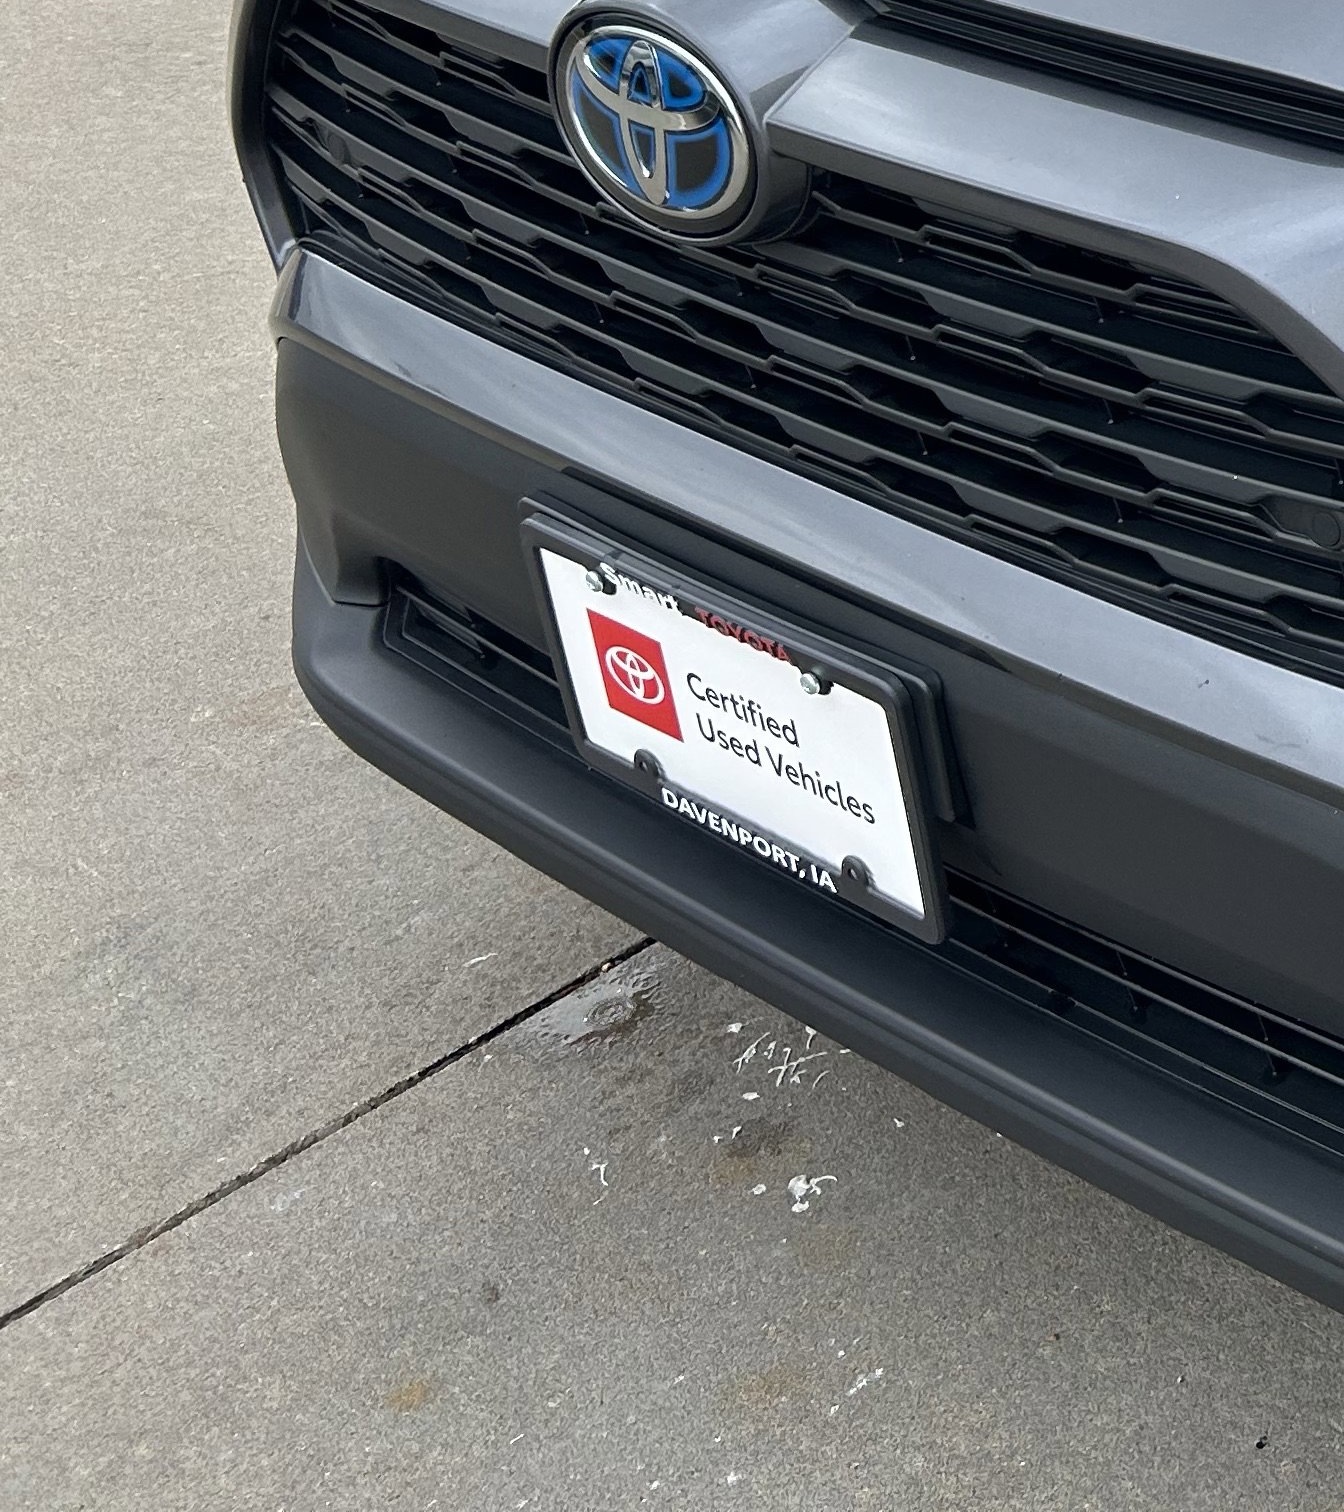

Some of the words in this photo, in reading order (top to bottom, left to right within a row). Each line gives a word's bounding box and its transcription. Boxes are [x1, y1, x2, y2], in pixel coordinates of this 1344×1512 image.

[600, 562, 680, 610] Smart
[694, 606, 791, 662] TOYOTA
[686, 672, 800, 748] Certified
[695, 712, 762, 768] Used
[765, 745, 875, 825] Vehicles
[661, 787, 806, 880] DAVENPORT,
[810, 864, 838, 894] IA
